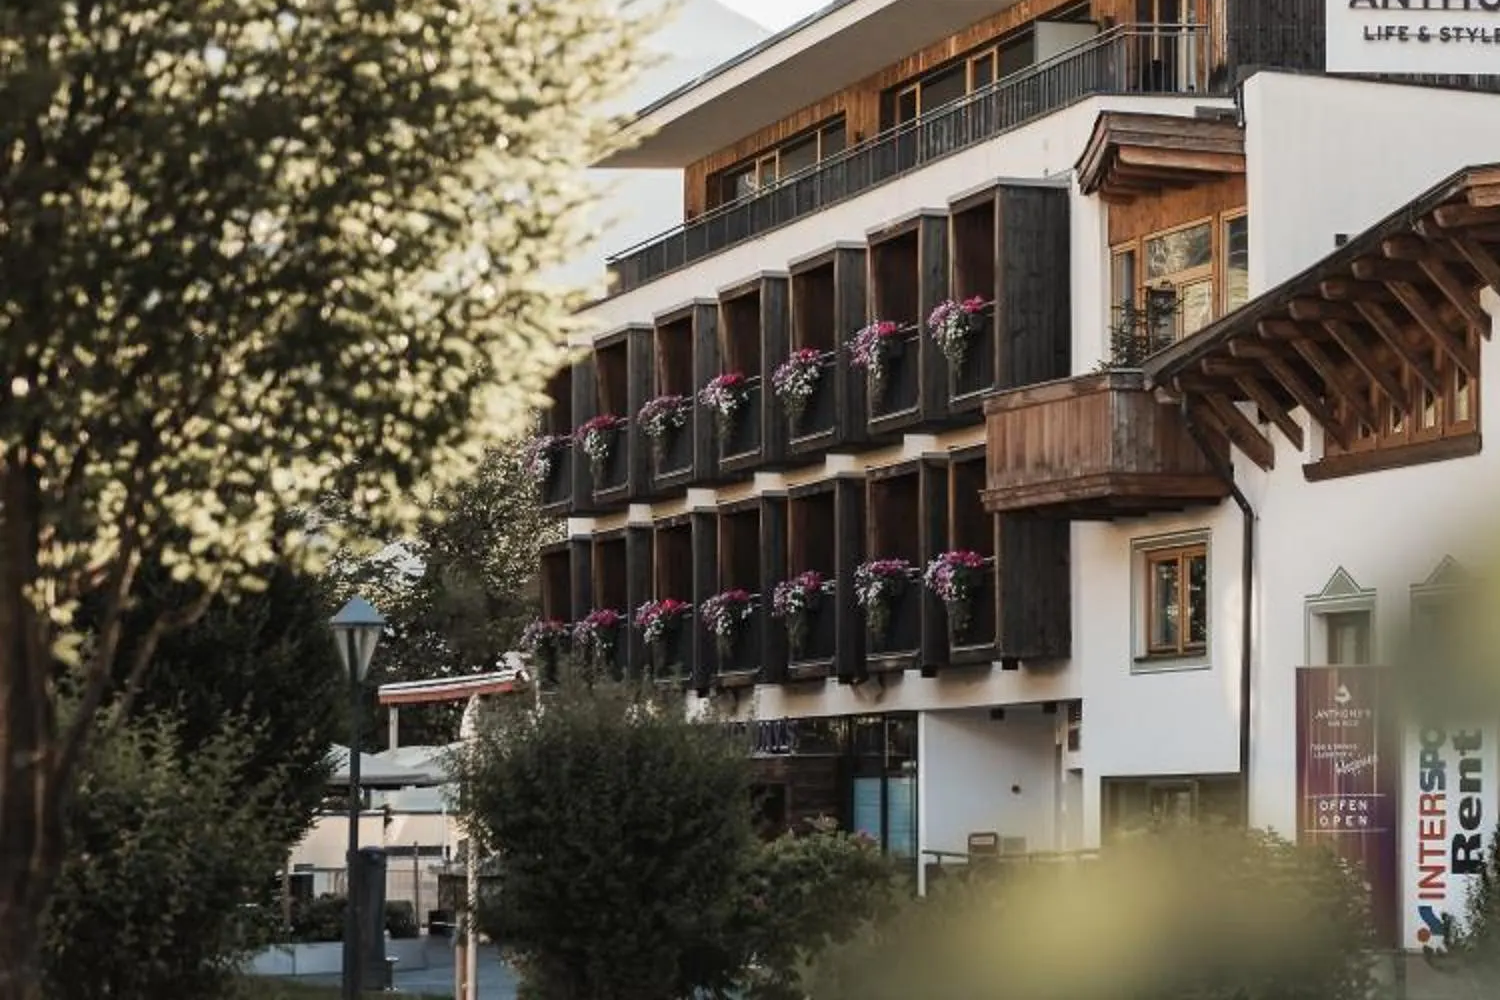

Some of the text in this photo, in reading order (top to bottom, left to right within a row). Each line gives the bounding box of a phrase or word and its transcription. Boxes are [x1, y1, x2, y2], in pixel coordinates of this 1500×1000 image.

[1363, 26, 1409, 42] LIFE
[1417, 27, 1431, 42] &
[1319, 799, 1368, 811] OFFEN
[1452, 727, 1483, 875] Rent
[1319, 815, 1368, 827] OPEN
[1417, 727, 1447, 900] INTERSPO
